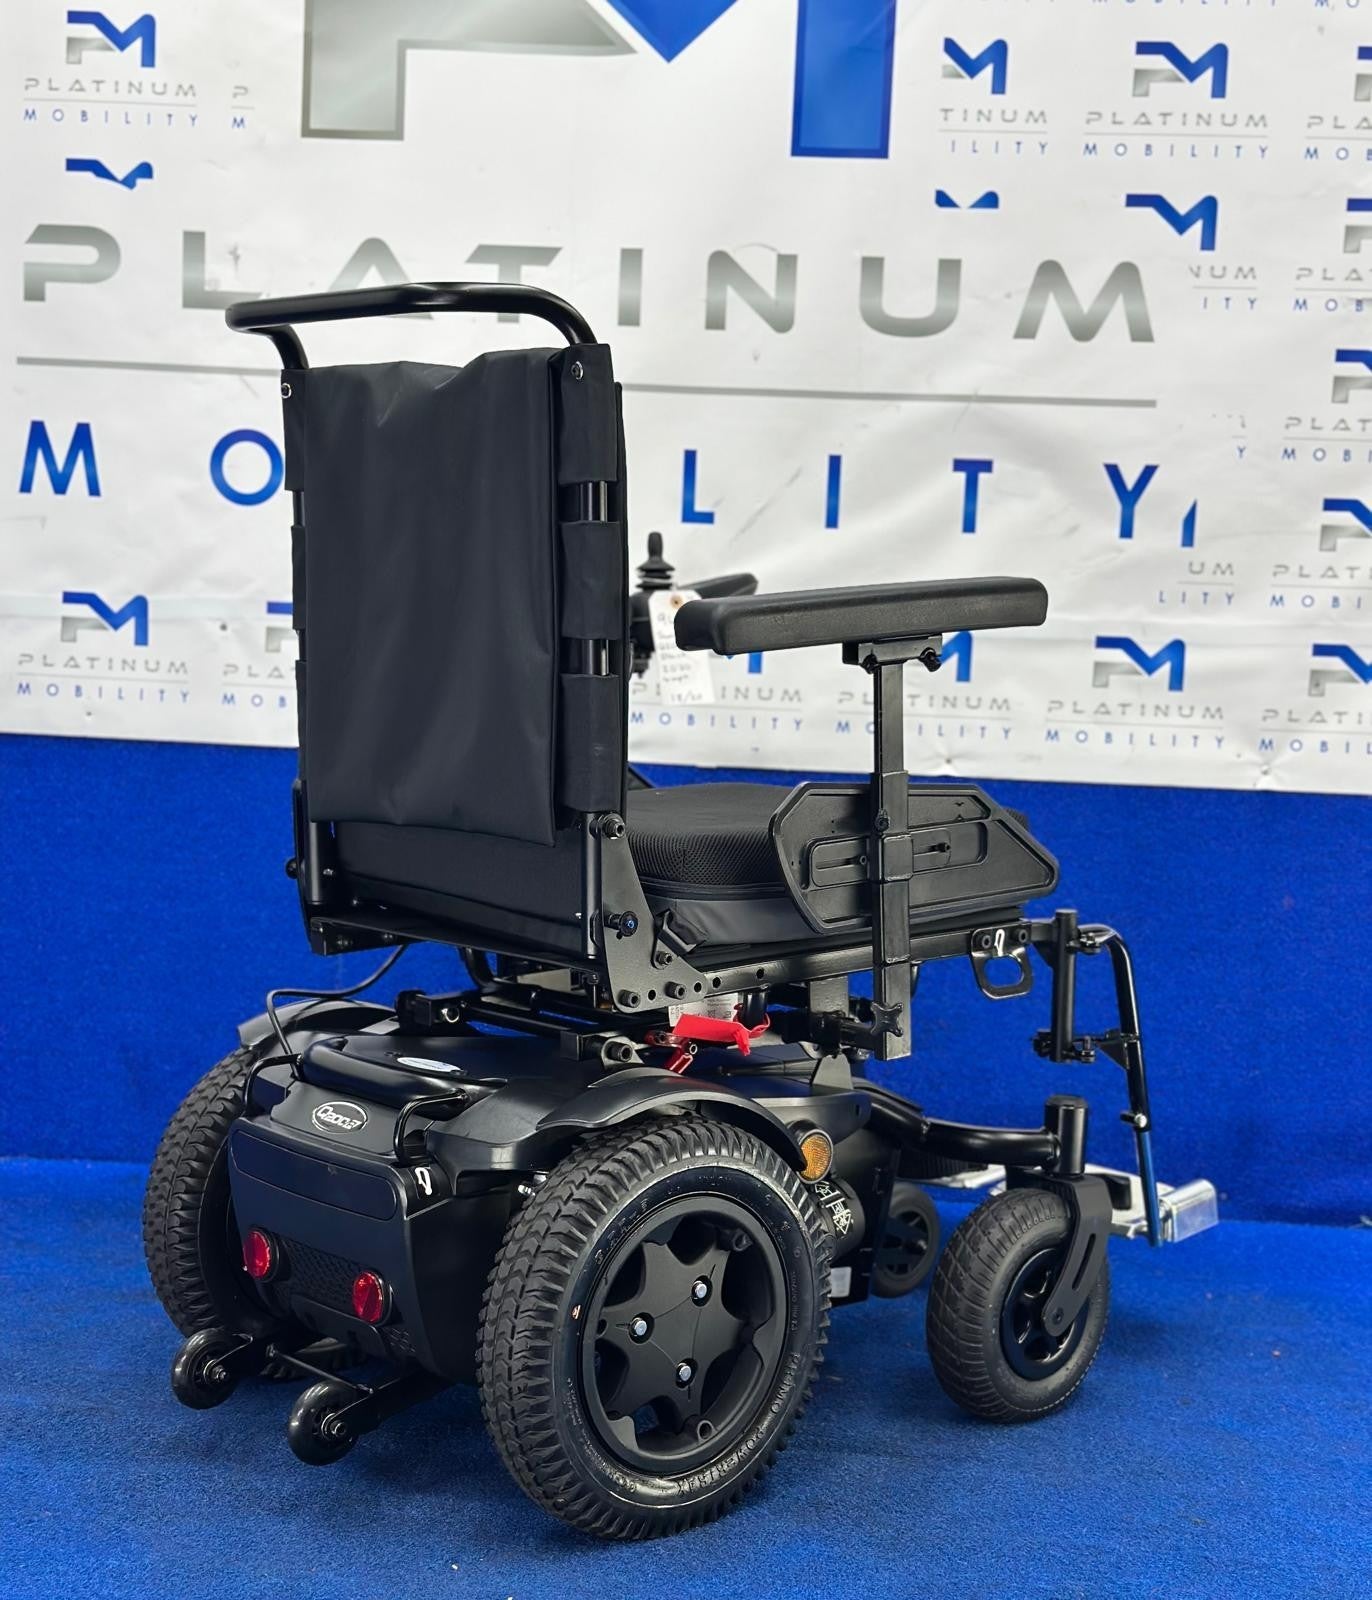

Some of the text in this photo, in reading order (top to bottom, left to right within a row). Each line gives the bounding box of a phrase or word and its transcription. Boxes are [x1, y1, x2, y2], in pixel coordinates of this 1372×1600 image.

[24, 79, 197, 98] PLATINUM
[24, 109, 197, 126] MOBILITY
[1085, 111, 1268, 128] PLATINUM
[1083, 143, 1268, 158] MOBILITY
[23, 223, 1155, 342] PLATINUM
[1295, 267, 1372, 282] PLA
[19, 420, 1160, 540] MOLITY
[17, 654, 188, 675] PLATINUM
[223, 664, 294, 679] PLA
[17, 682, 189, 702] MOBILITY
[837, 691, 1011, 711] PLTINUM
[1046, 700, 1224, 720] PLATINUM
[631, 711, 803, 730] MOBILITY
[836, 720, 1012, 740] MOILITY
[1045, 729, 1225, 749] MOBILITY
